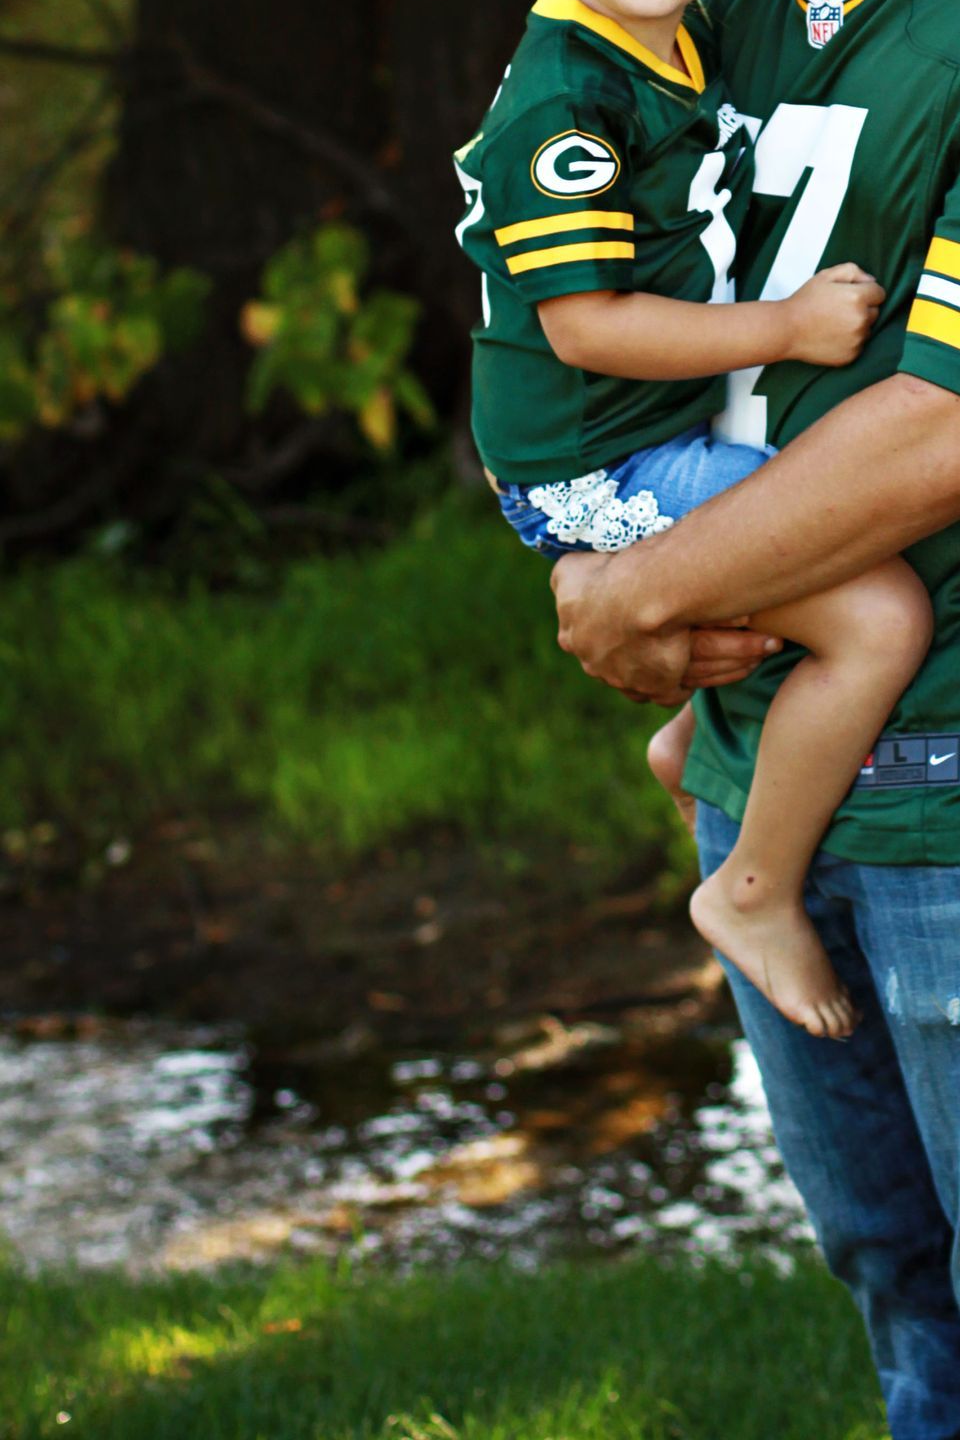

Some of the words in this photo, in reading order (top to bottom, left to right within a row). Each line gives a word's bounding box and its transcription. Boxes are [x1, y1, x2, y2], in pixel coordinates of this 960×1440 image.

[535, 133, 616, 194] G
[711, 102, 869, 450] 7
[893, 742, 908, 763] L
